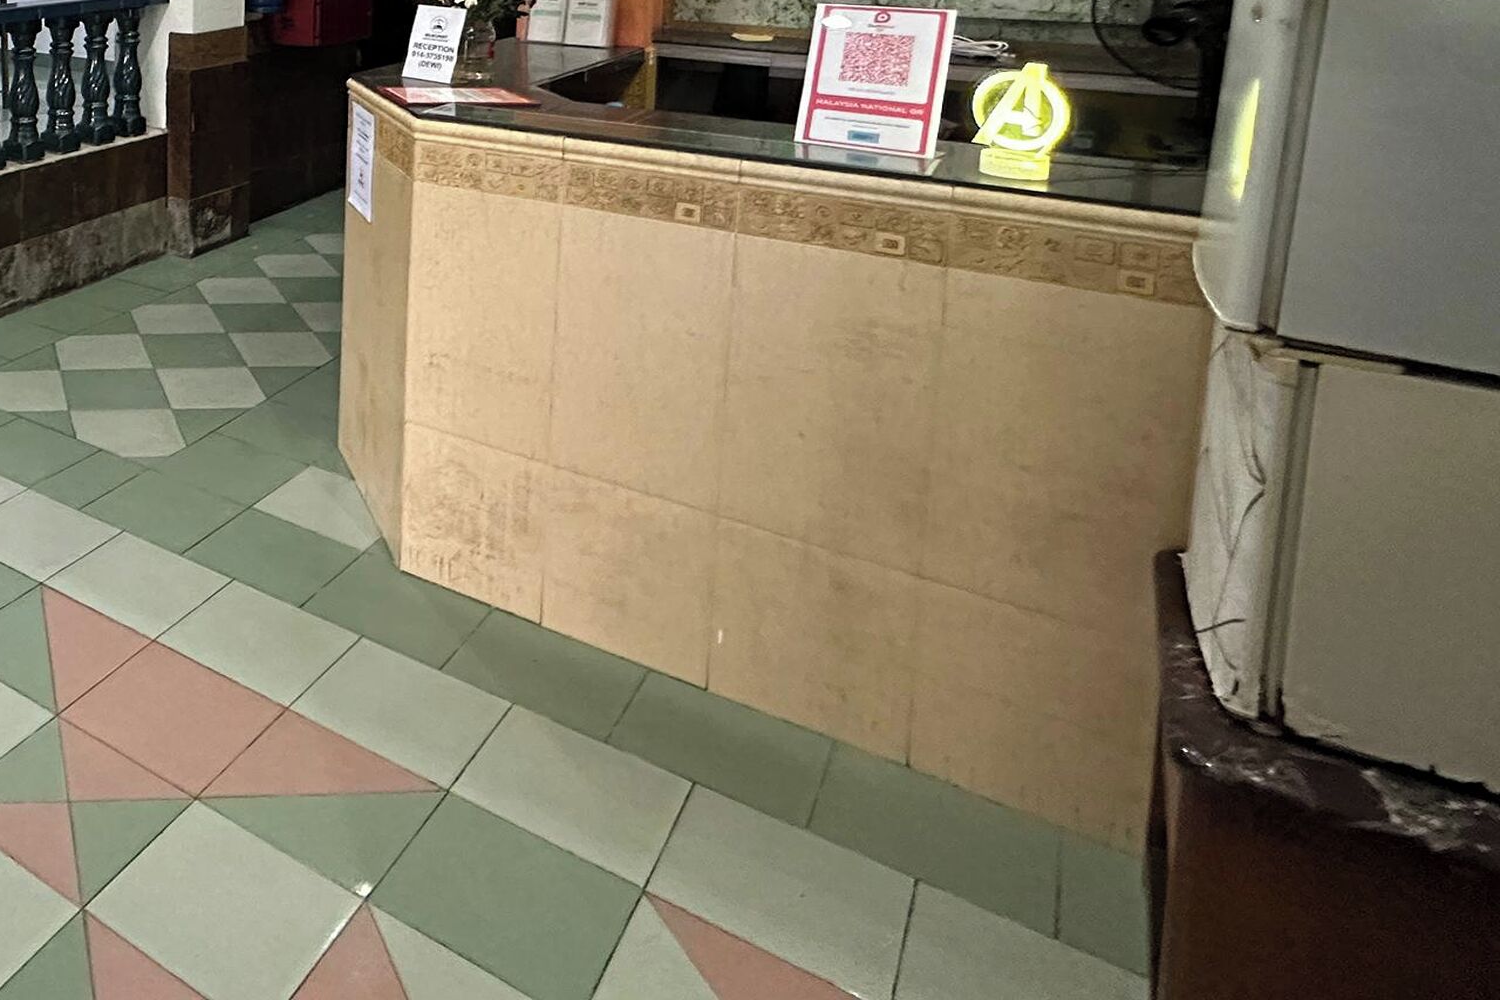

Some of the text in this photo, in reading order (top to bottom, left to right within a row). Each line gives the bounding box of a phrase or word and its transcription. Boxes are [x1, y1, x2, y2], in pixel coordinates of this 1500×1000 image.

[412, 41, 454, 54] RECEPTION
[815, 98, 860, 109] MALAYSIA
[860, 103, 907, 114] NATIONAL
